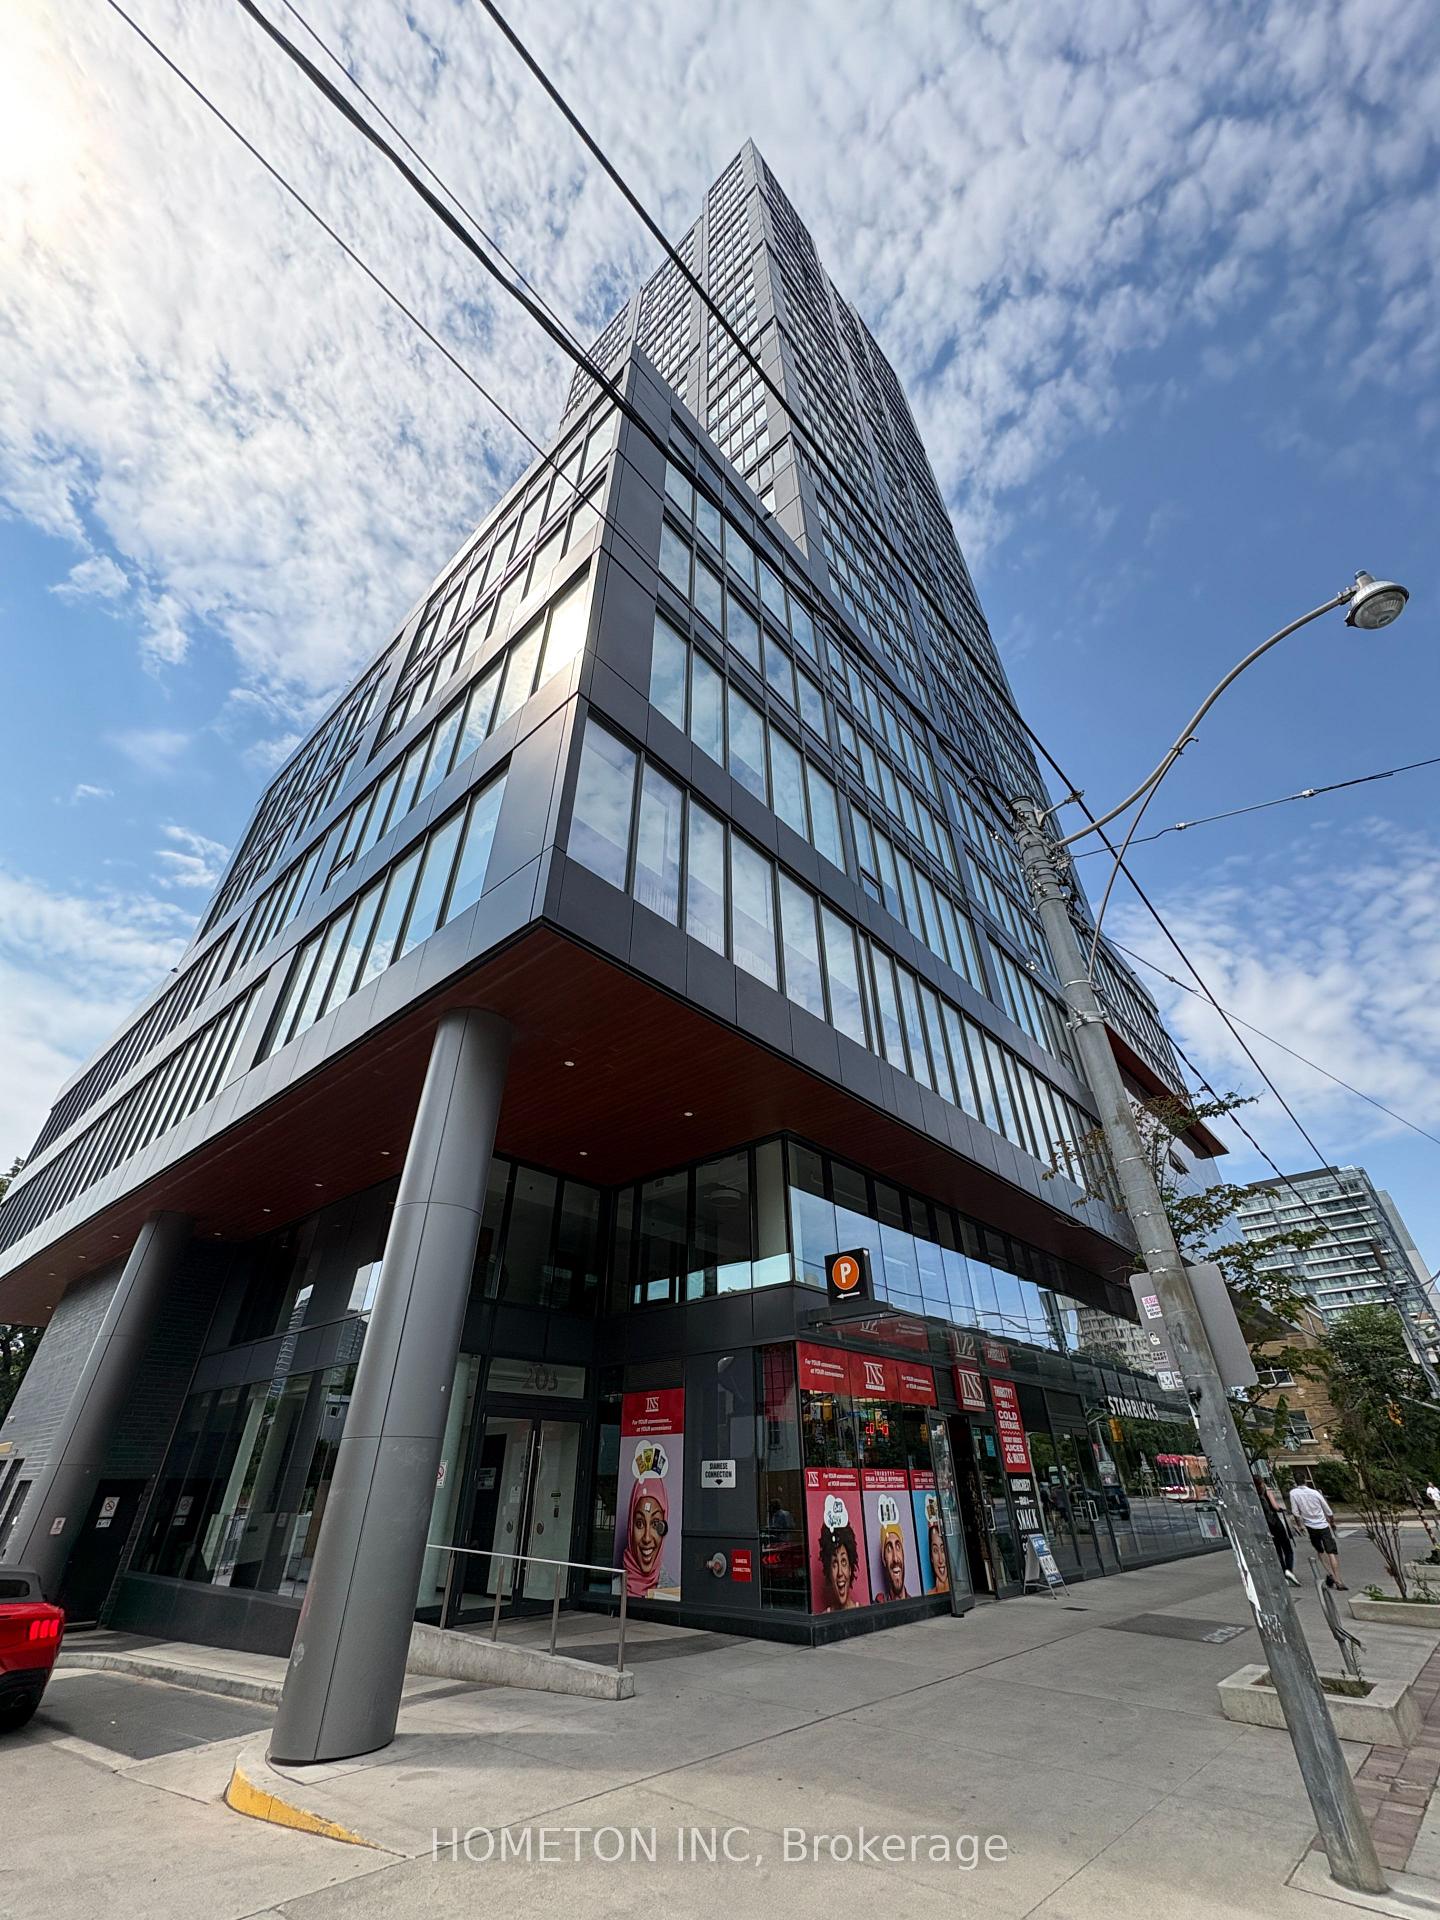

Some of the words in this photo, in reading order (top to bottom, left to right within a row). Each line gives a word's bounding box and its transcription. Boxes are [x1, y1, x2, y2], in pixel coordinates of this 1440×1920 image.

[840, 1262, 851, 1283] P
[864, 1364, 884, 1385] INS
[960, 1373, 984, 1400] INS
[998, 1410, 1018, 1421] COLD
[1107, 1395, 1159, 1421] STARBUCKS
[1016, 1509, 1039, 1530] SNACK
